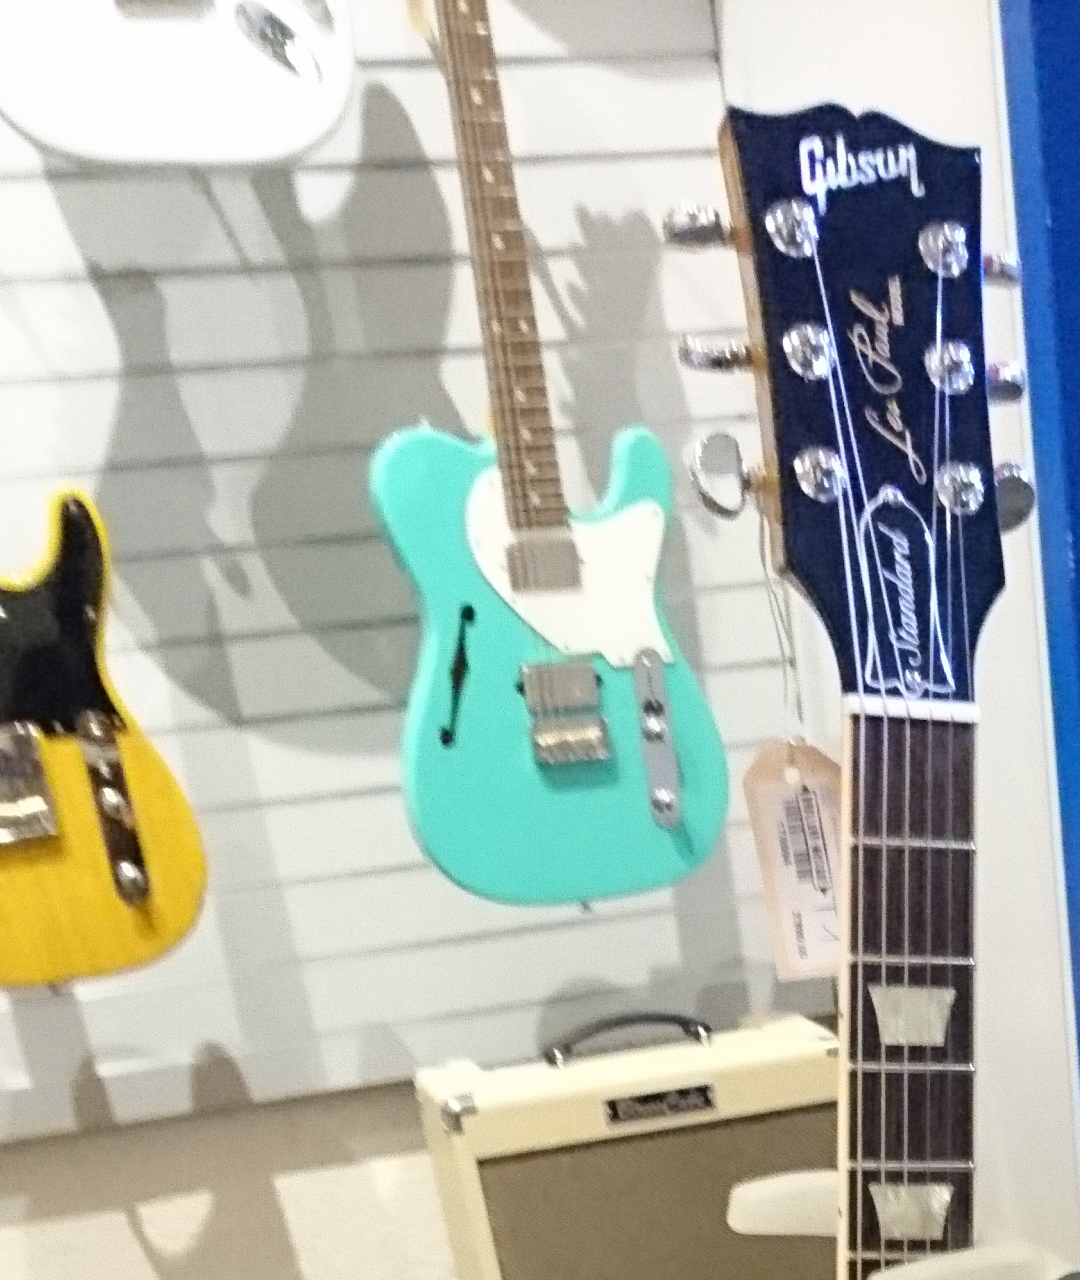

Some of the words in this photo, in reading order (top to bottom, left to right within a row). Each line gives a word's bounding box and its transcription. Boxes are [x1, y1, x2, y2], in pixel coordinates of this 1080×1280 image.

[798, 131, 926, 216] Gibson
[846, 288, 903, 395] Paul
[864, 398, 928, 486] Les
[876, 520, 923, 667] Standard
